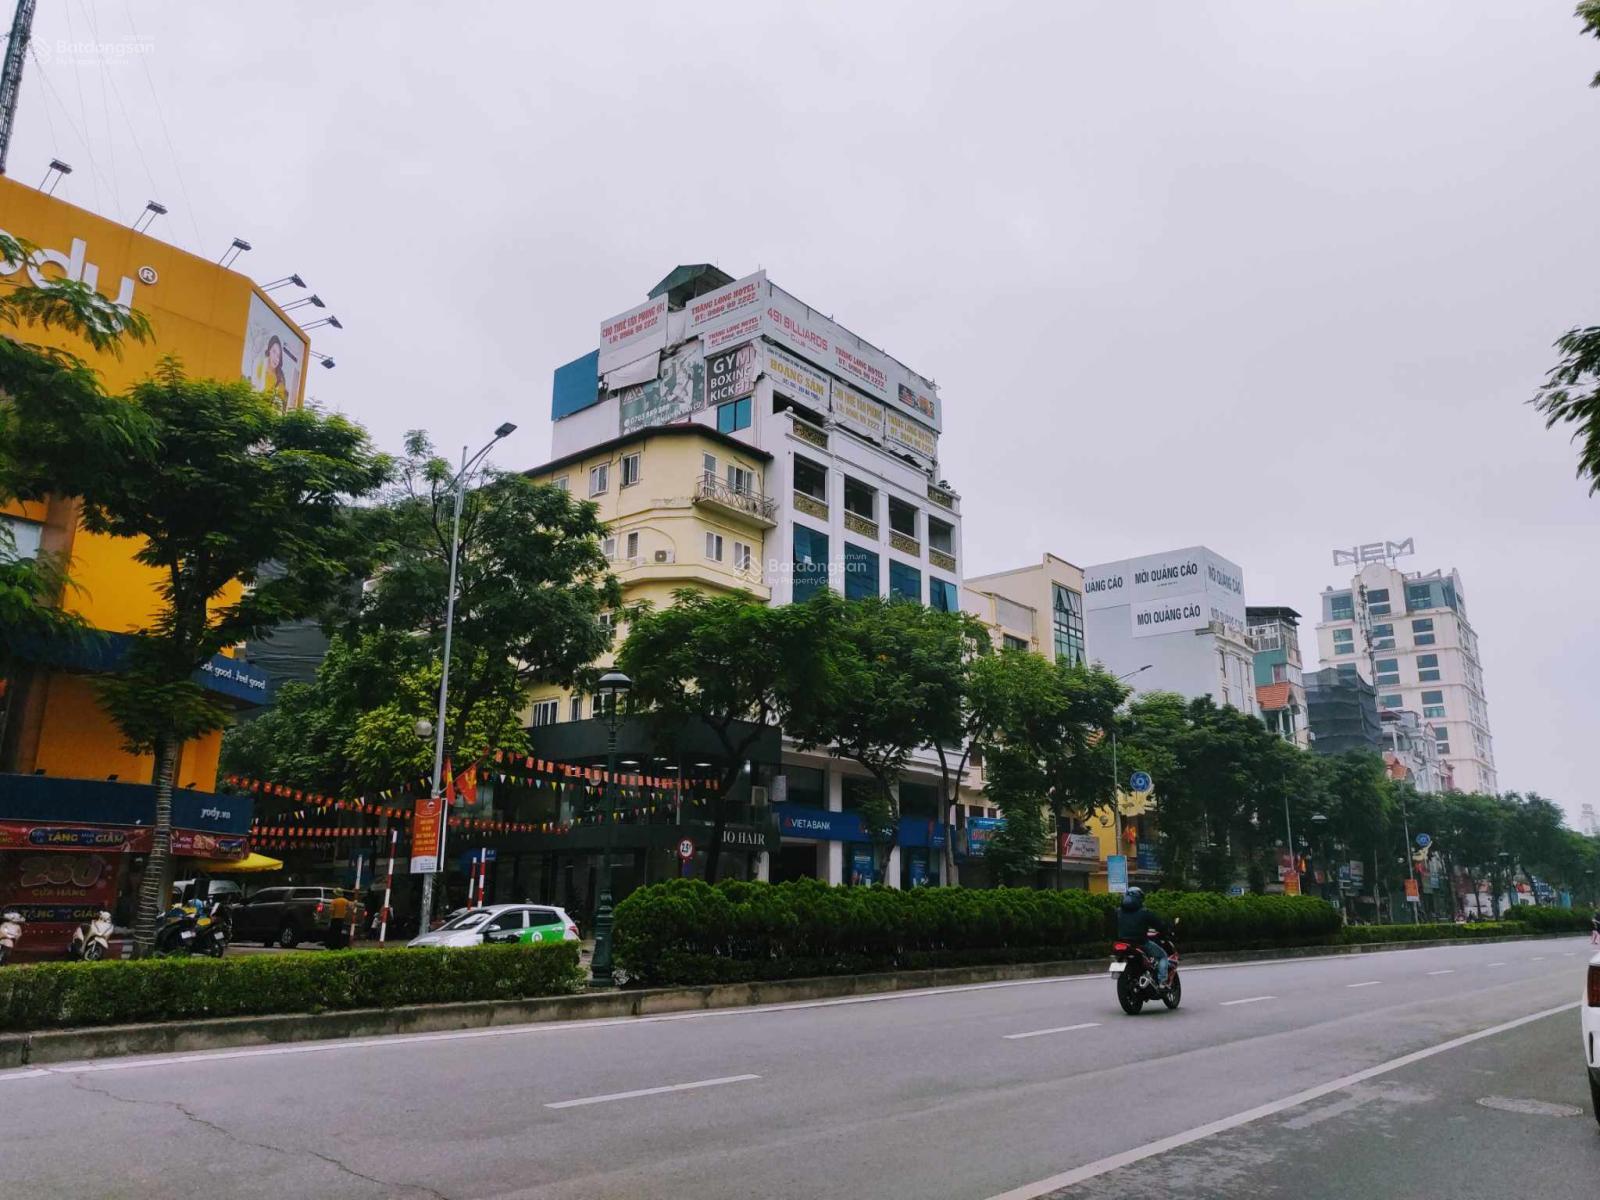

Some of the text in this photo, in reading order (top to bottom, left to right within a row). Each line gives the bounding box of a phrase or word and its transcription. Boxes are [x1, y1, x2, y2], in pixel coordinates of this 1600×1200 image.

[733, 283, 755, 298] HOTEL
[767, 307, 828, 351] 491 BILLIARDS
[713, 349, 751, 373] GYM
[710, 366, 752, 389] BOXING
[1332, 537, 1415, 567] NEM
[1151, 564, 1179, 582] QUẢNG
[1180, 560, 1198, 577] CÁO
[1107, 574, 1123, 590] CÁO
[1153, 605, 1182, 623] QUẢNG
[1183, 602, 1201, 618] CÁO
[250, 678, 266, 690] good
[200, 807, 231, 820] yody.vn
[738, 831, 766, 846] HAIR
[20, 856, 105, 888] 250
